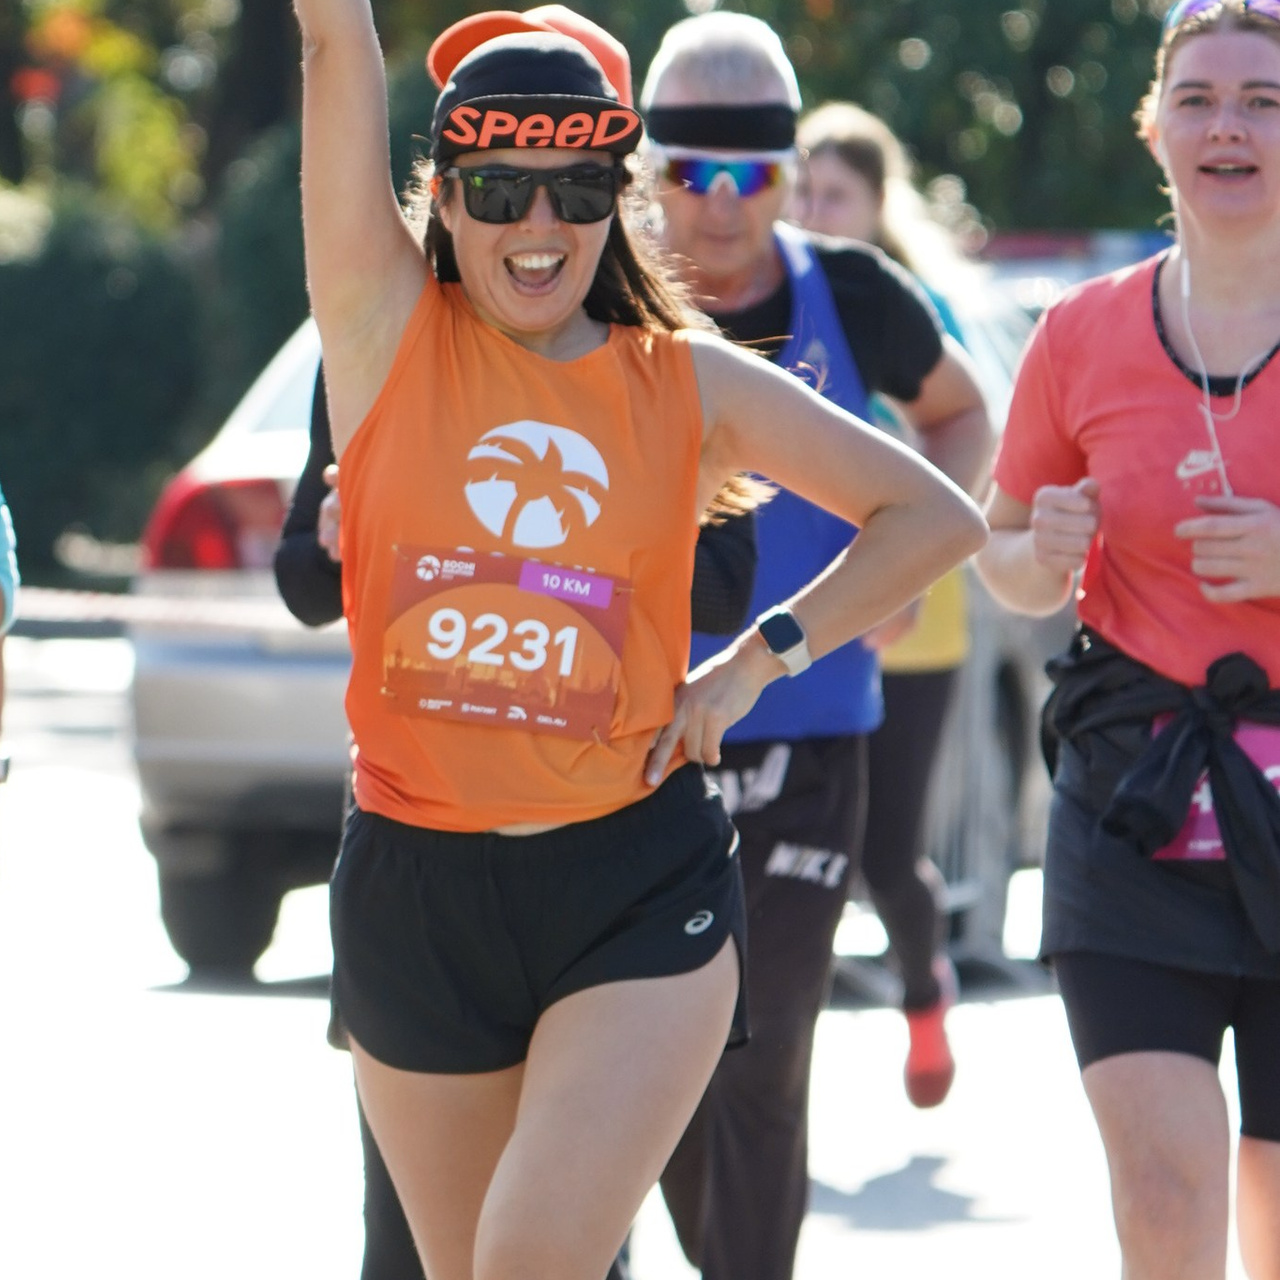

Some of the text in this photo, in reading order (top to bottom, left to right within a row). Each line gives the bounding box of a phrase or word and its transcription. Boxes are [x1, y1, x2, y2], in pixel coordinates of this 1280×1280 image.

[542, 573, 591, 597] 10 KM
[426, 607, 579, 677] 9231
